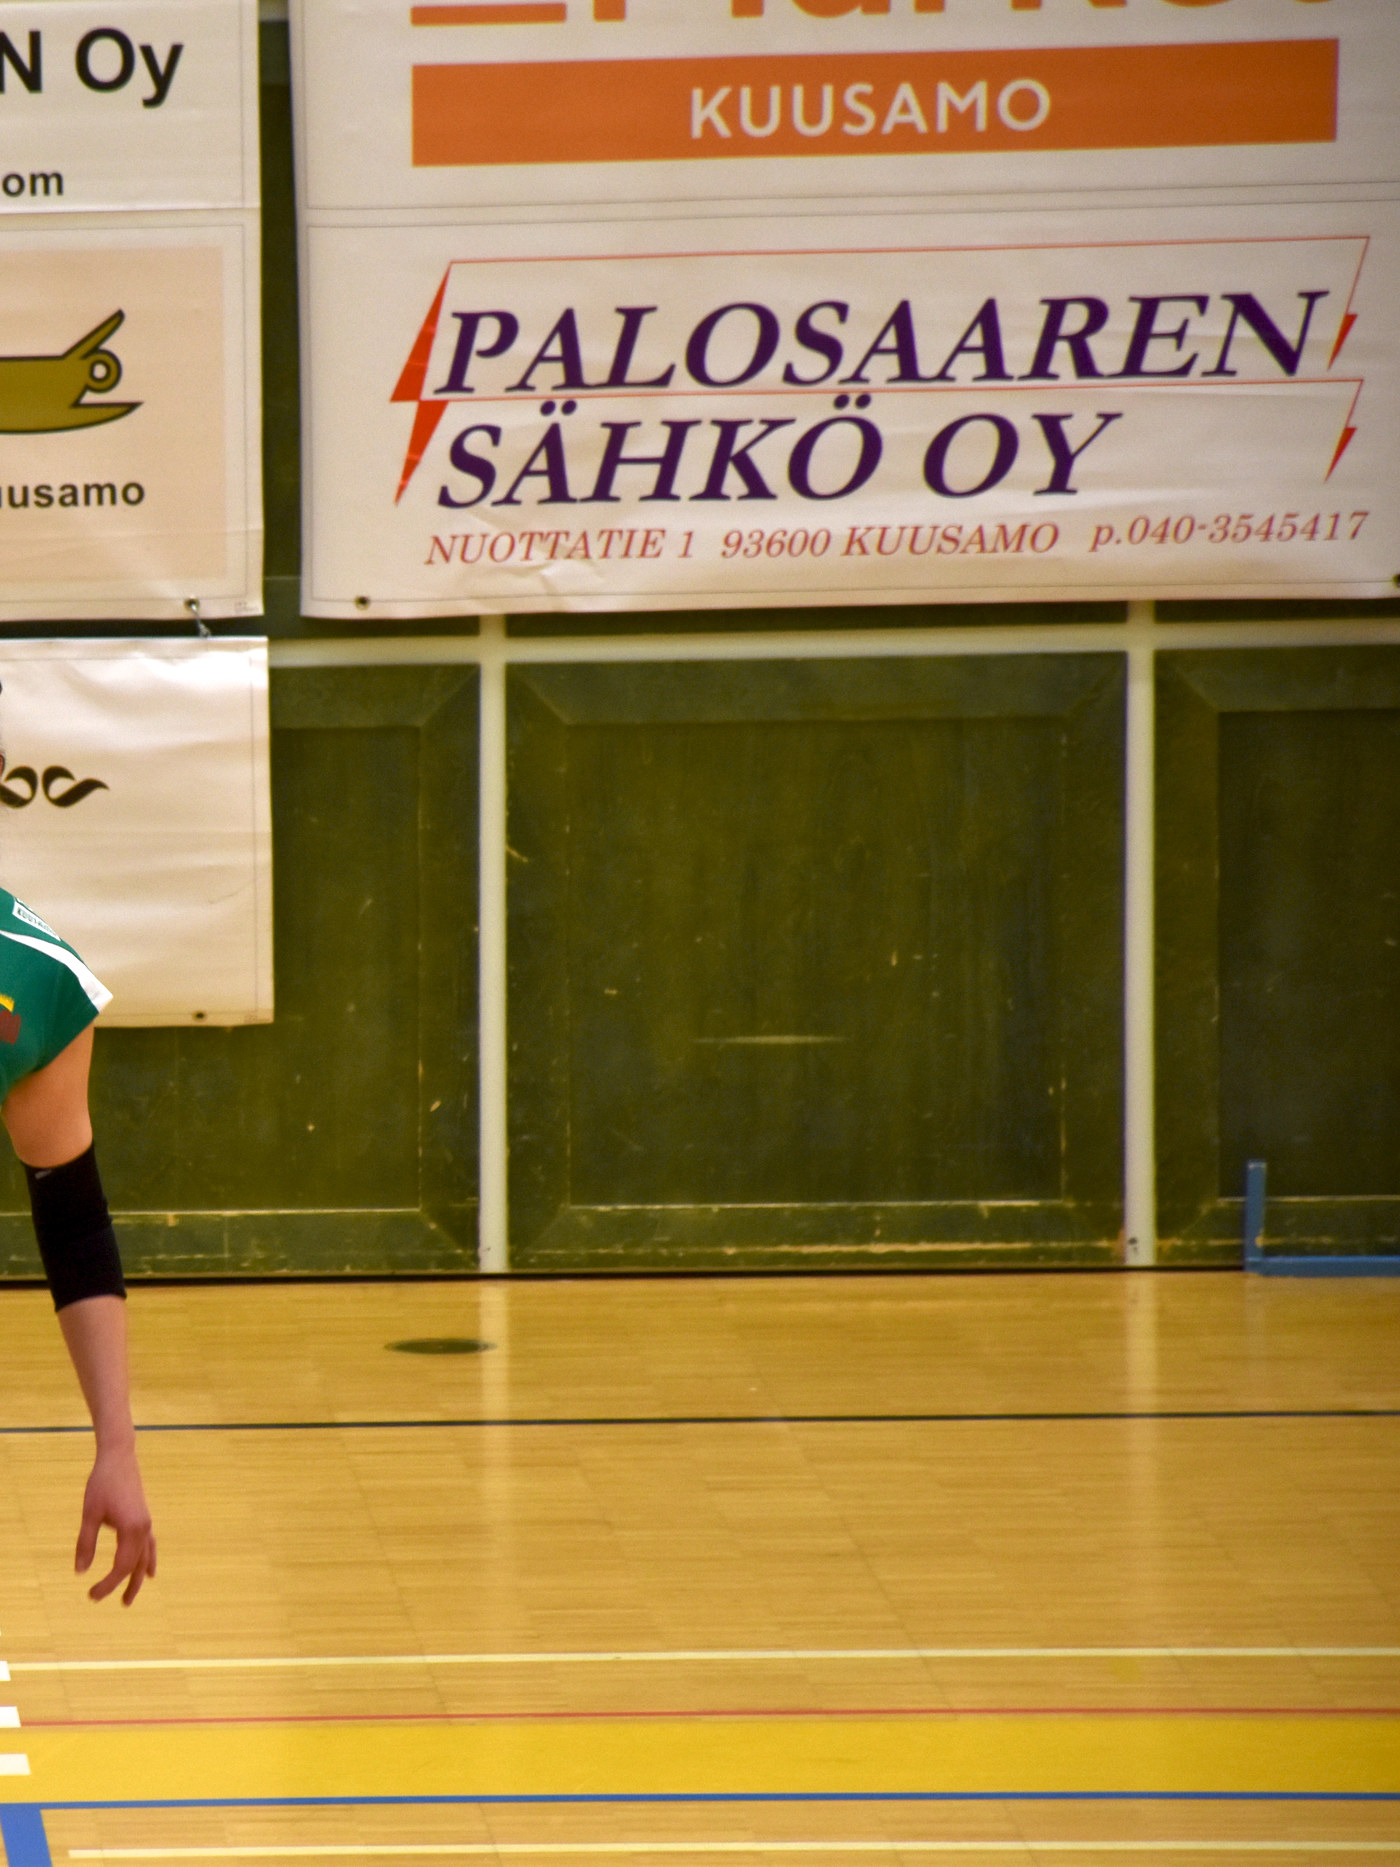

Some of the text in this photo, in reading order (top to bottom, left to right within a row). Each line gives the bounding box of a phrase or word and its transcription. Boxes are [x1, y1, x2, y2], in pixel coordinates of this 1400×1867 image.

[75, 27, 183, 108] Oy
[691, 79, 1050, 139] KUUSAMO
[434, 291, 1330, 395] PALOSAAREN
[438, 394, 1123, 508] SÄHKÖ OY
[424, 511, 1370, 565] NUOTTATIE 1 93600 KUUSAMO p.040-3545417
